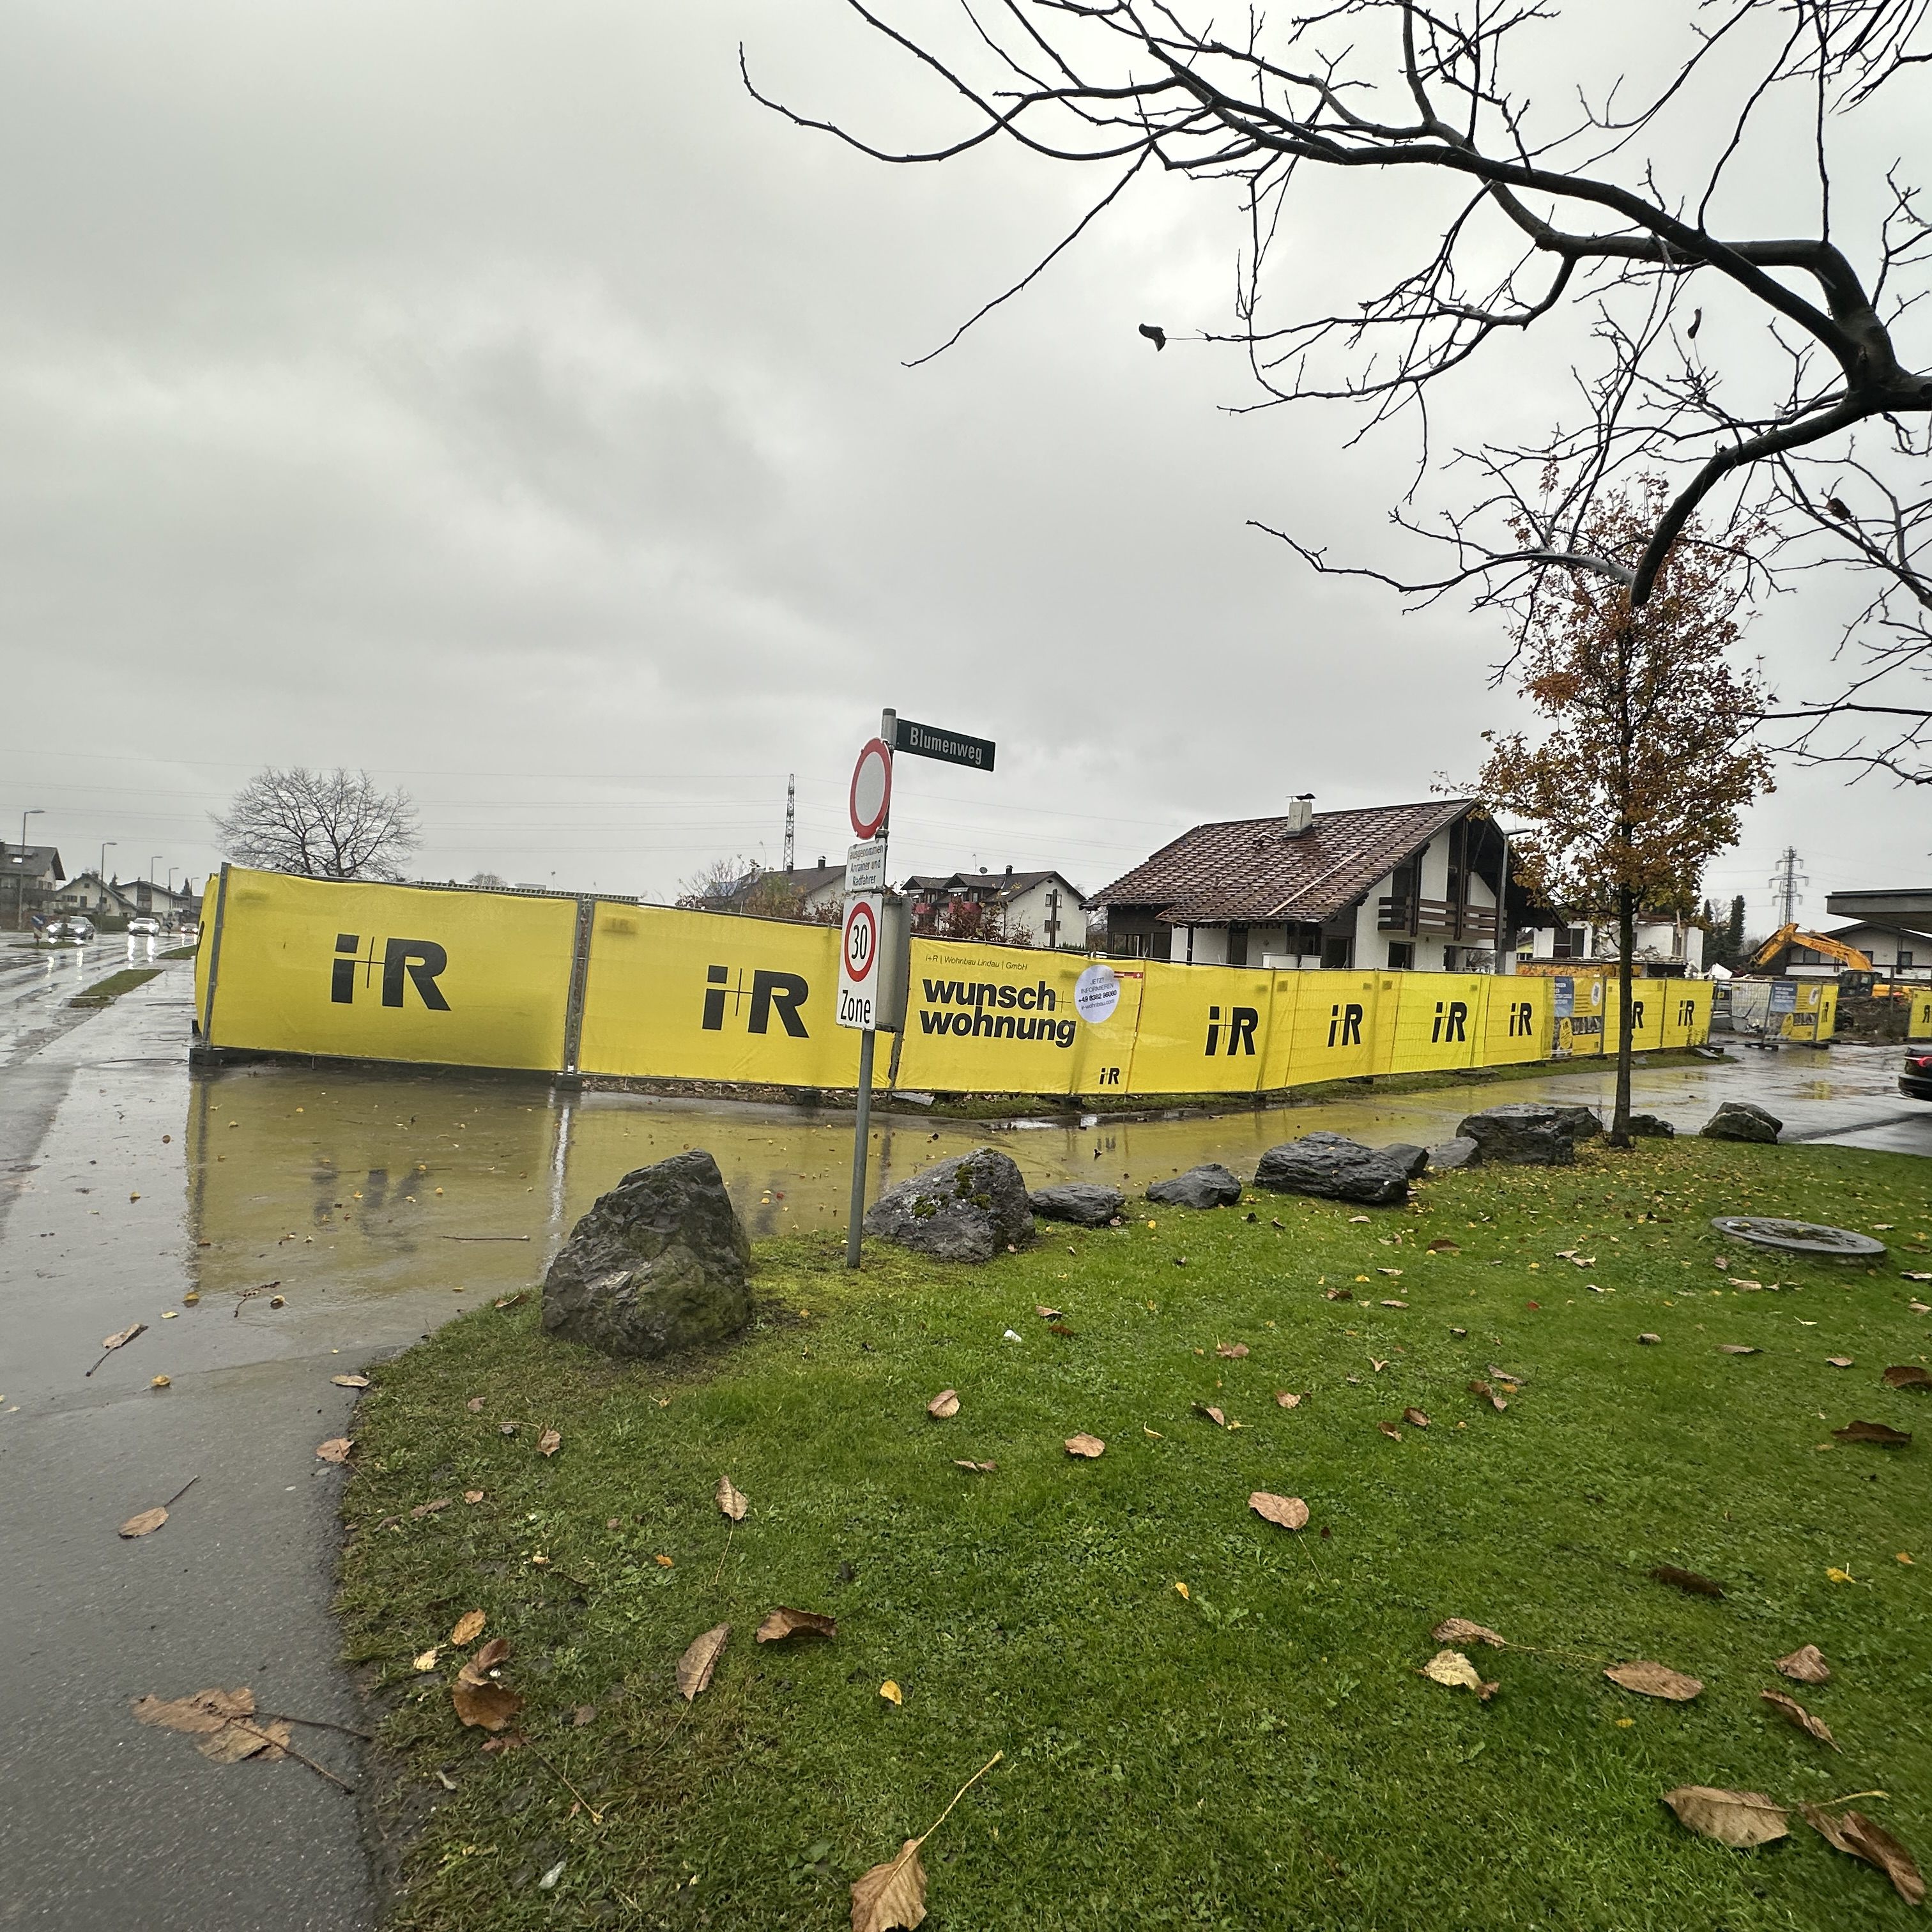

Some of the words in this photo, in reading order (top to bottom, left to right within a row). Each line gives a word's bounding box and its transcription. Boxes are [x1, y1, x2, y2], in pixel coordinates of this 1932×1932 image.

[910, 726, 983, 765] Blumenweg
[849, 845, 884, 861] ausgenommen
[850, 861, 871, 873] Anrainer
[871, 857, 881, 870] und
[852, 875, 877, 887] Radfahrer
[851, 924, 868, 960] 30
[944, 956, 976, 966] Wohnbau
[977, 958, 1000, 968] Lindau
[1006, 962, 1028, 971] GmbH
[840, 989, 871, 1024] Zone
[919, 1006, 1077, 1048] wohnung
